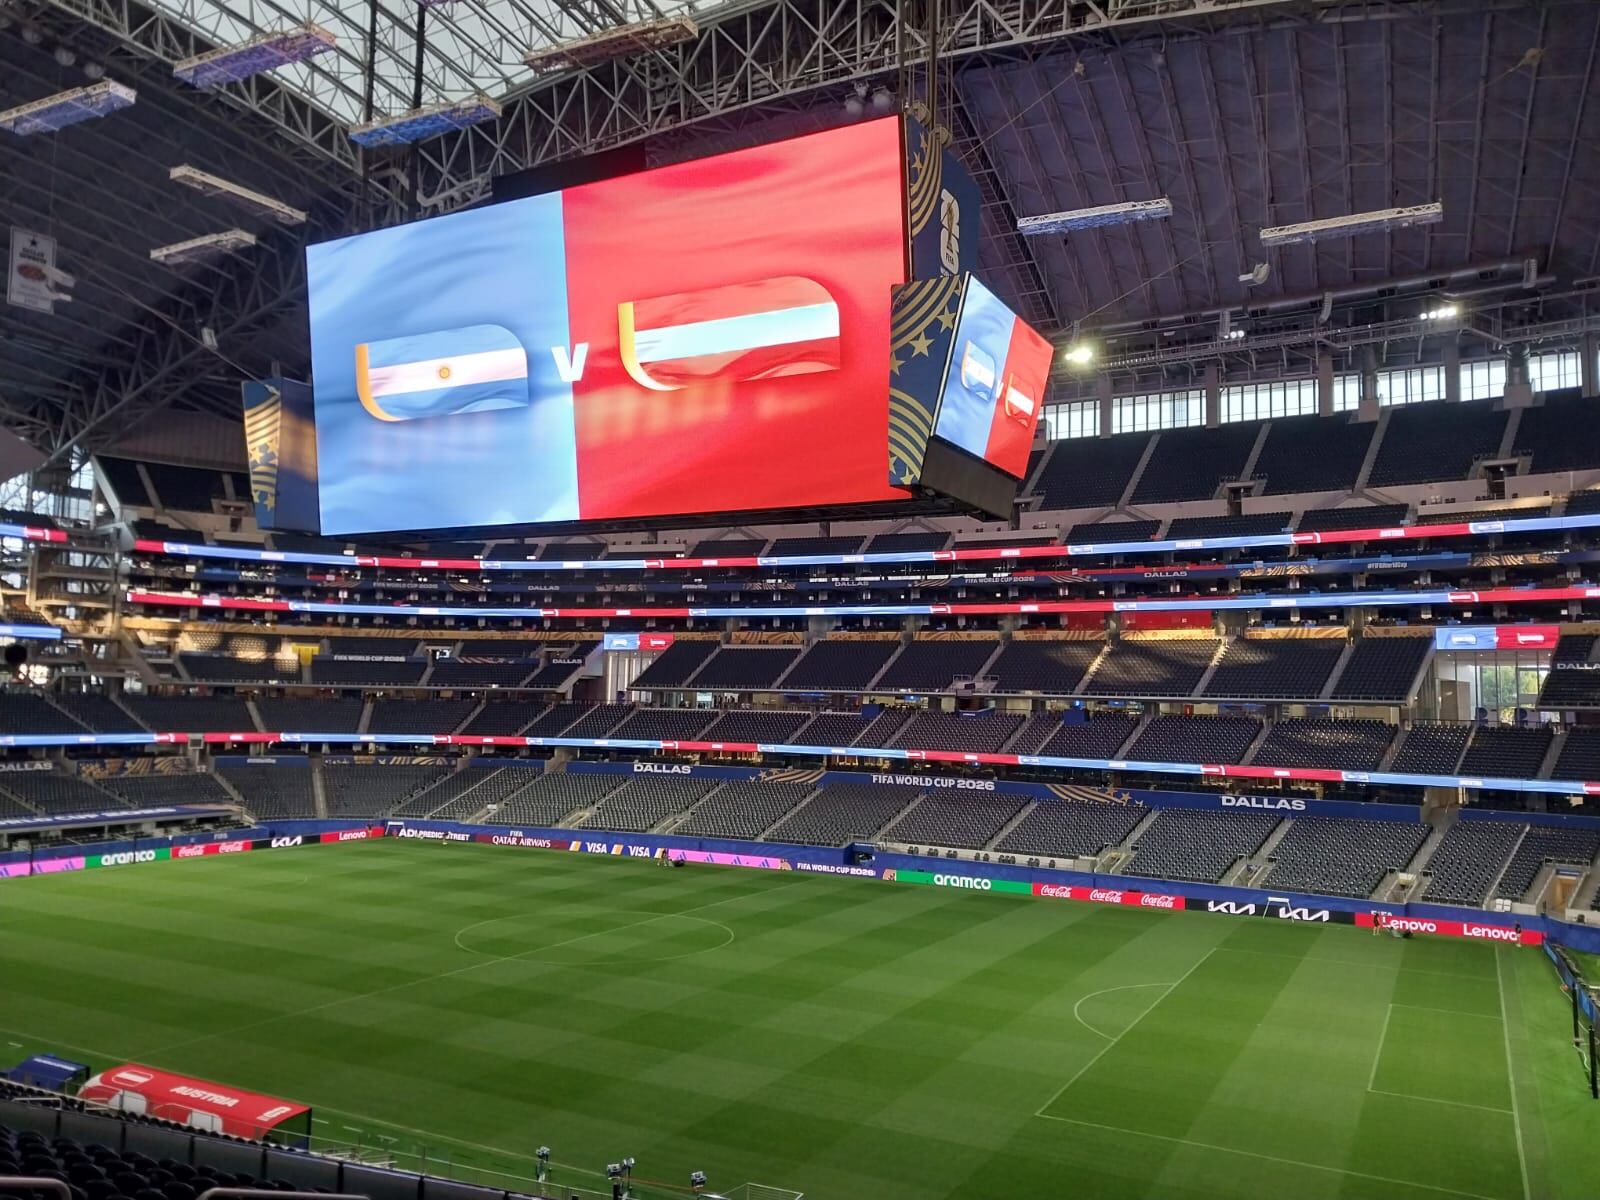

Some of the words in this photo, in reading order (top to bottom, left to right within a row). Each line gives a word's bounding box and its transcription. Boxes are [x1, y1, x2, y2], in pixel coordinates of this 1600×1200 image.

[633, 763, 692, 775] DALLAS
[872, 775, 894, 785] FIFA
[896, 776, 933, 788] WORLD
[934, 777, 955, 788] CUP
[956, 779, 995, 791] 2026
[1221, 795, 1306, 811] DALLAS
[338, 831, 367, 841] Lenovo
[510, 830, 523, 838] FIFA
[492, 835, 518, 846] QATAR
[519, 837, 551, 848] AIRWAYS
[585, 842, 607, 854] VISA
[101, 850, 155, 866] aramco
[627, 845, 650, 857] VISA
[797, 862, 811, 870] FIFA
[811, 863, 836, 873] WORLD
[836, 866, 850, 875] CUP
[933, 873, 992, 890] aramco
[1382, 916, 1437, 933] Lenovo
[1463, 923, 1519, 941] Lenovo
[169, 1085, 240, 1107] AUSTRIA
